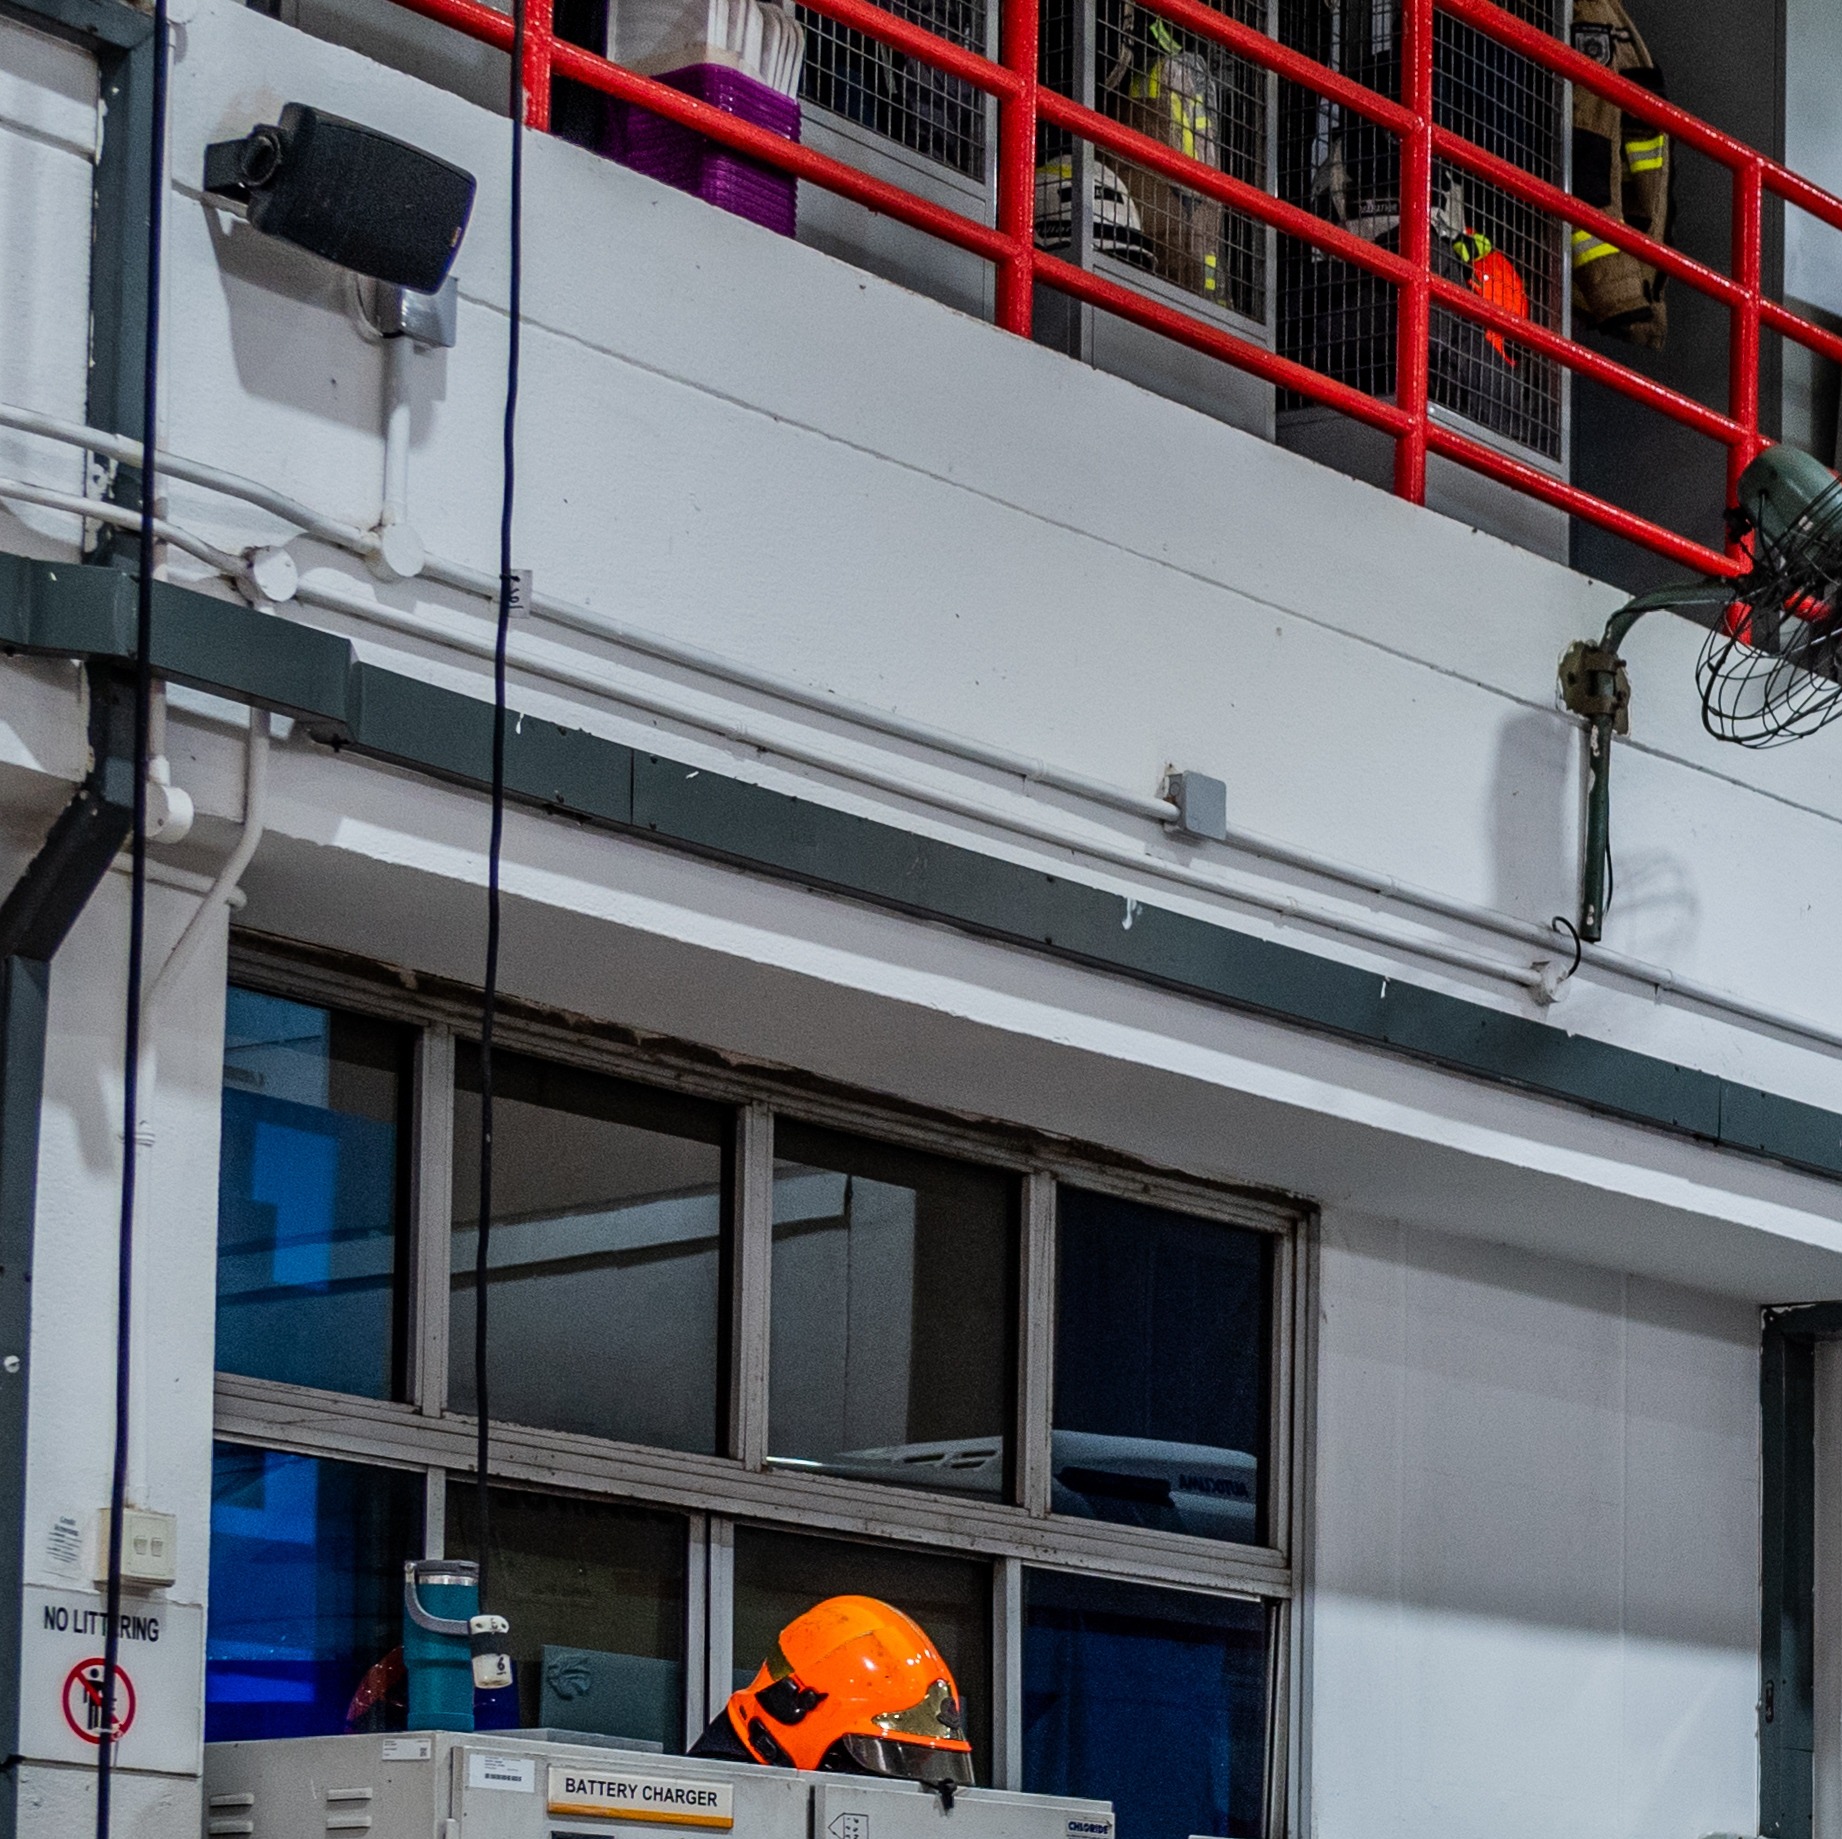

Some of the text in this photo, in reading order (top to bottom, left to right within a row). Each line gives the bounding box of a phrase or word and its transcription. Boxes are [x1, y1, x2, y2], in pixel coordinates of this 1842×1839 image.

[44, 1606, 159, 1642] NO LITTRING
[565, 1778, 717, 1807] BATTERY CHARGER
